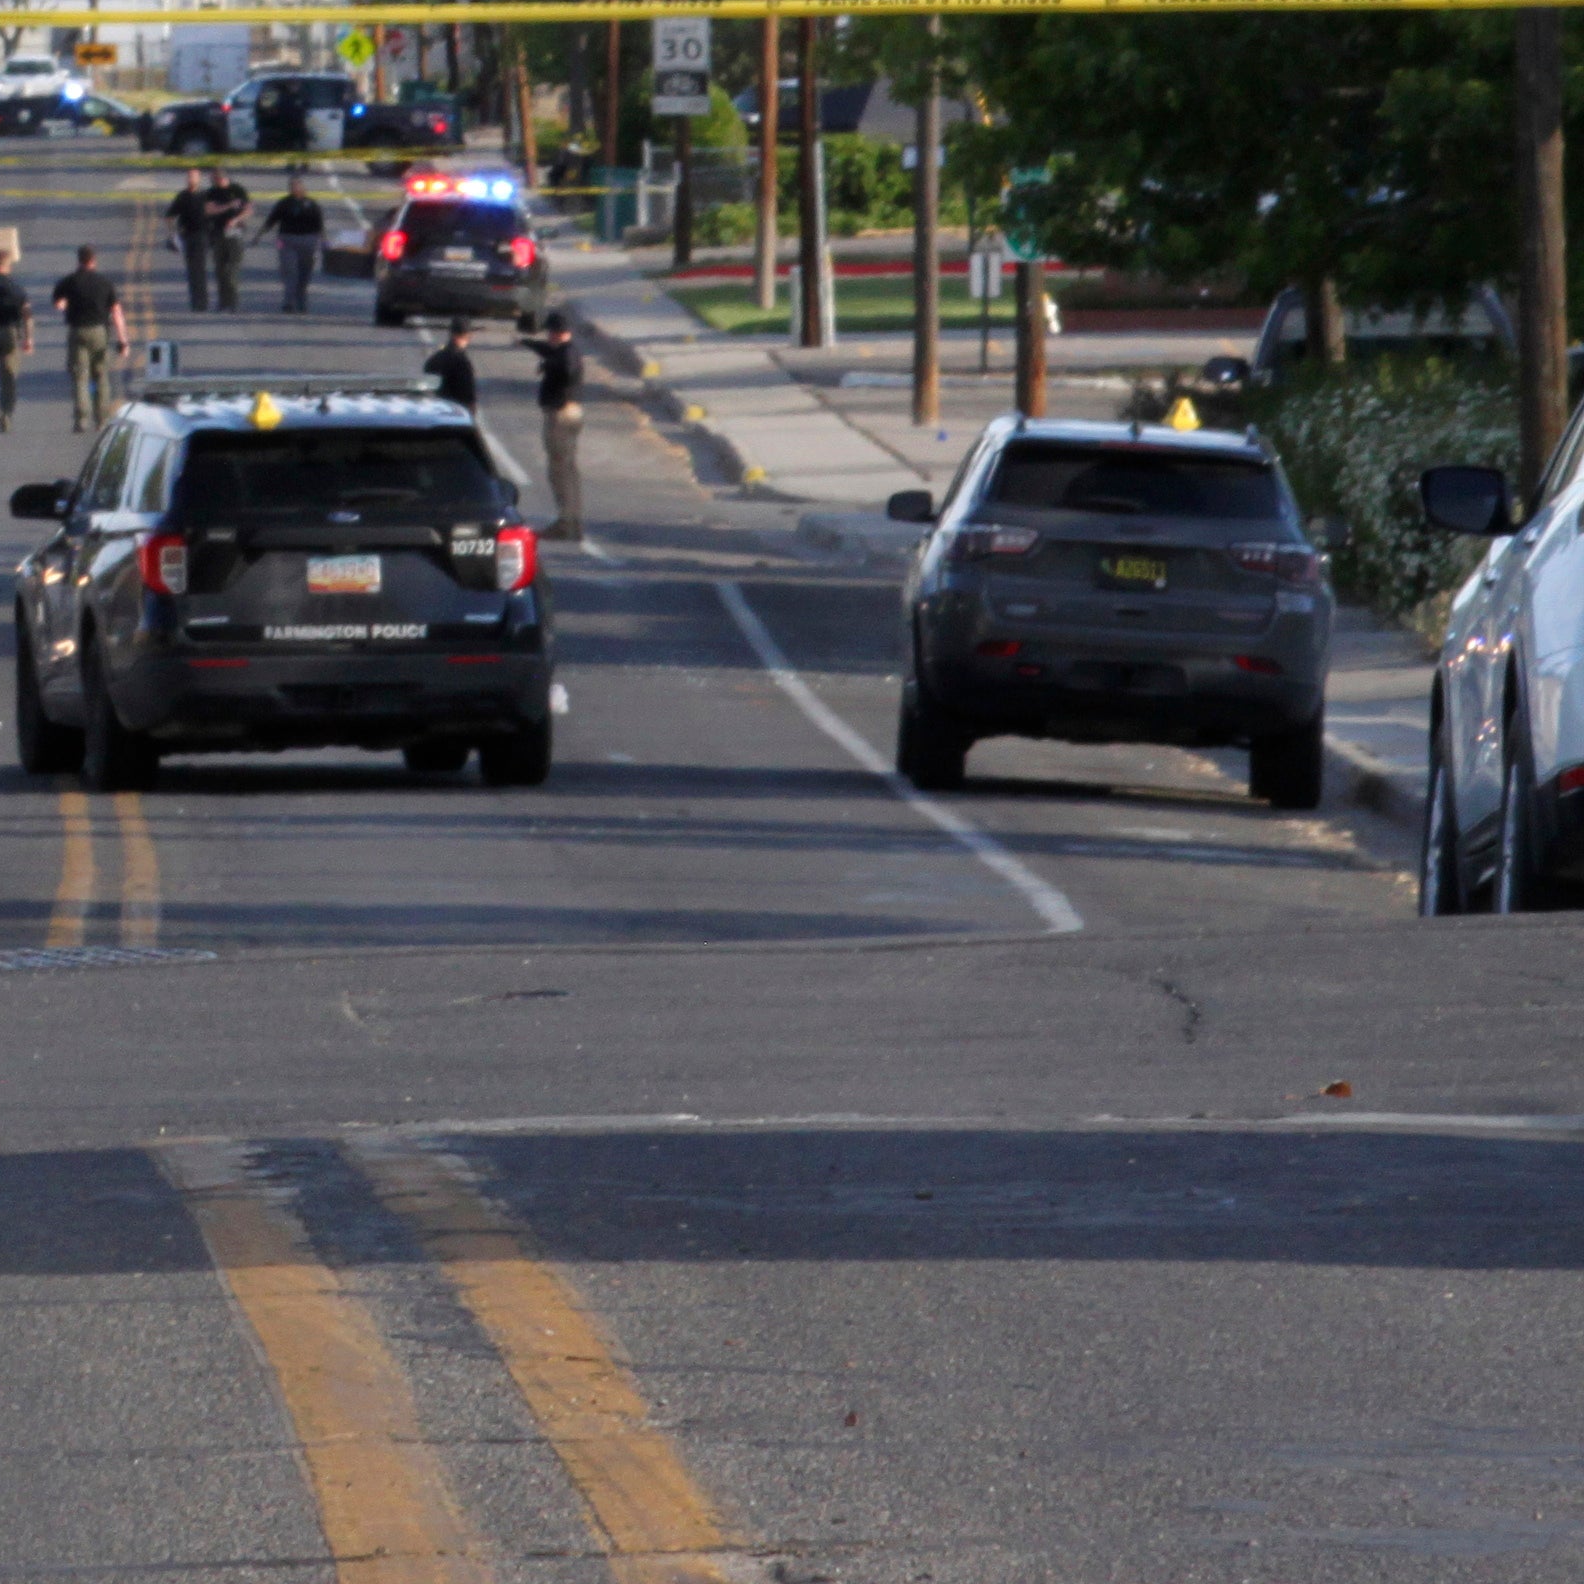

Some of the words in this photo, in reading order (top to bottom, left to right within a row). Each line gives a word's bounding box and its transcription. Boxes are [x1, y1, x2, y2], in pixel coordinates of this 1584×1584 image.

[661, 37, 703, 60] 30
[263, 624, 368, 640] FARMINGTON
[371, 622, 429, 640] POLICE
